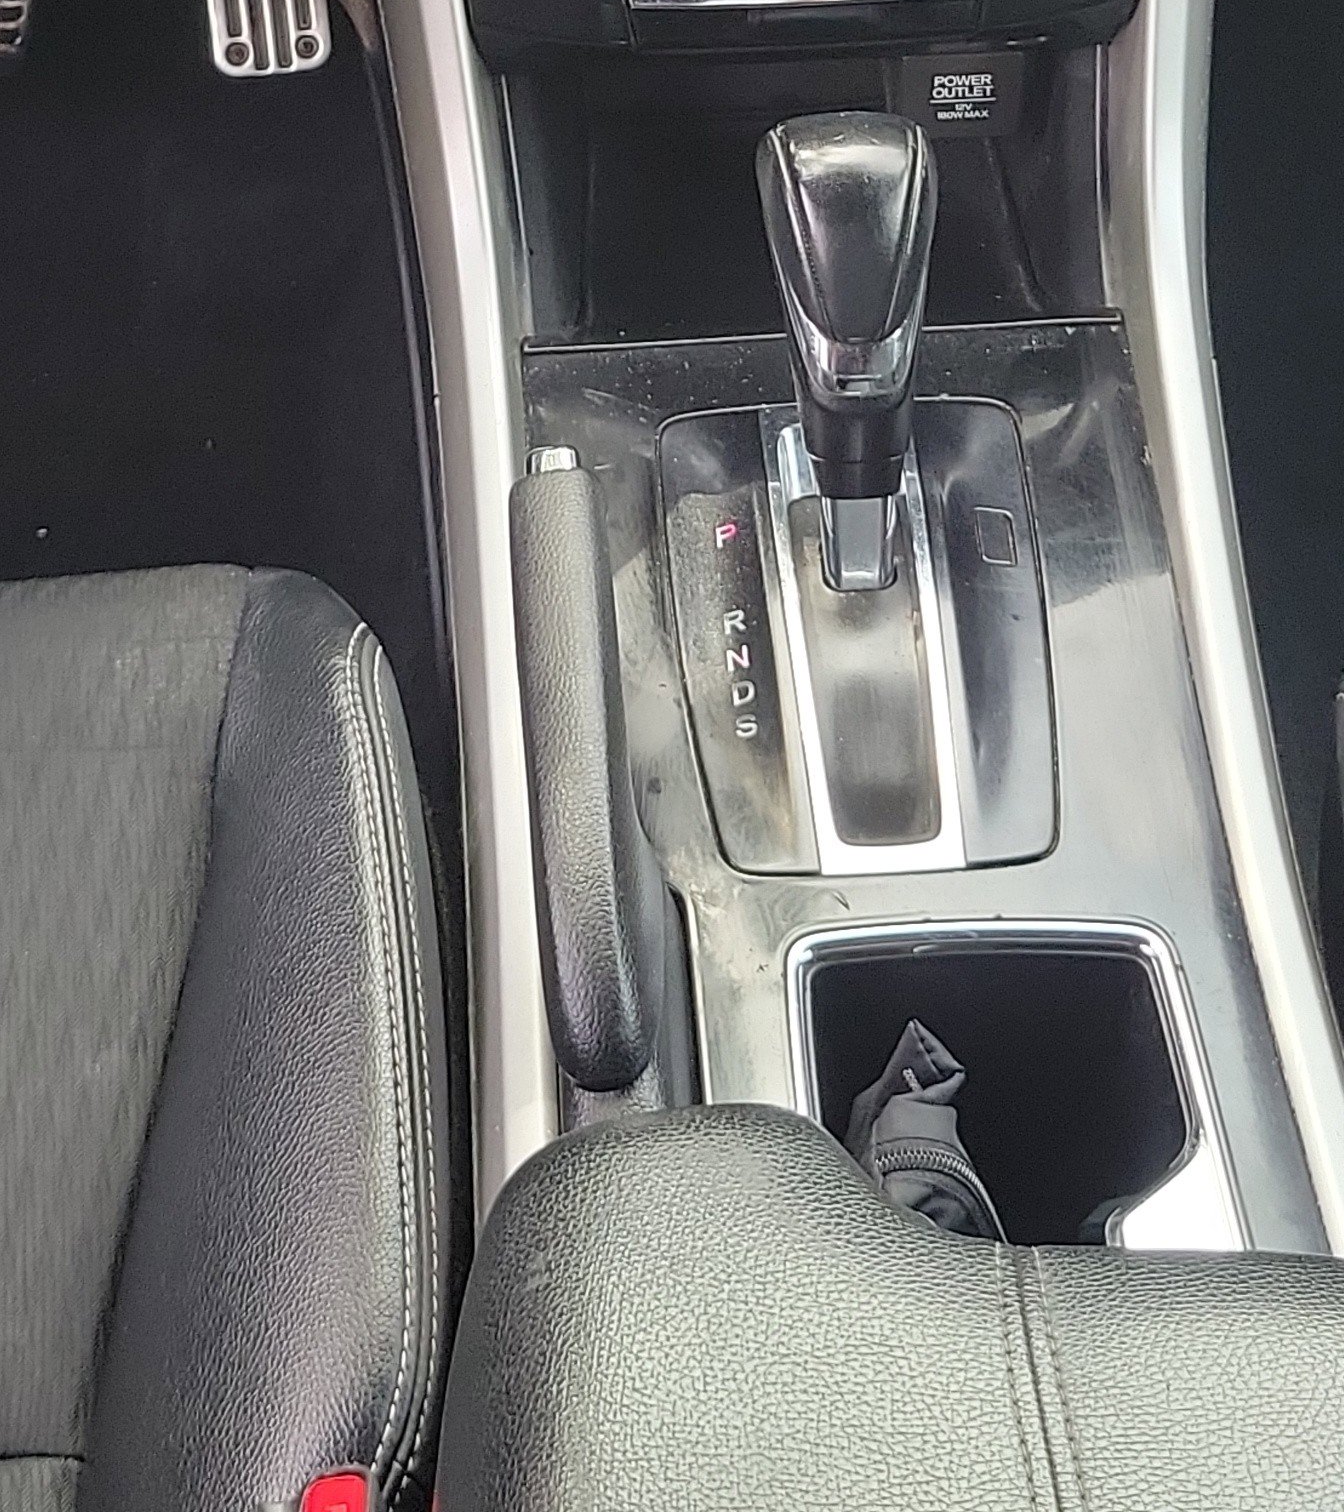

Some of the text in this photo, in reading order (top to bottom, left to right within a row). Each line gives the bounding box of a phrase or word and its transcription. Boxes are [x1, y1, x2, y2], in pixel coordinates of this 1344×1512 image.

[932, 86, 994, 98] OUTLET
[934, 74, 992, 86] POWER
[964, 109, 989, 119] MAX
[715, 523, 737, 548] P
[723, 609, 747, 635] R
[726, 644, 750, 673] N
[732, 680, 755, 707] D
[735, 715, 758, 739] S
